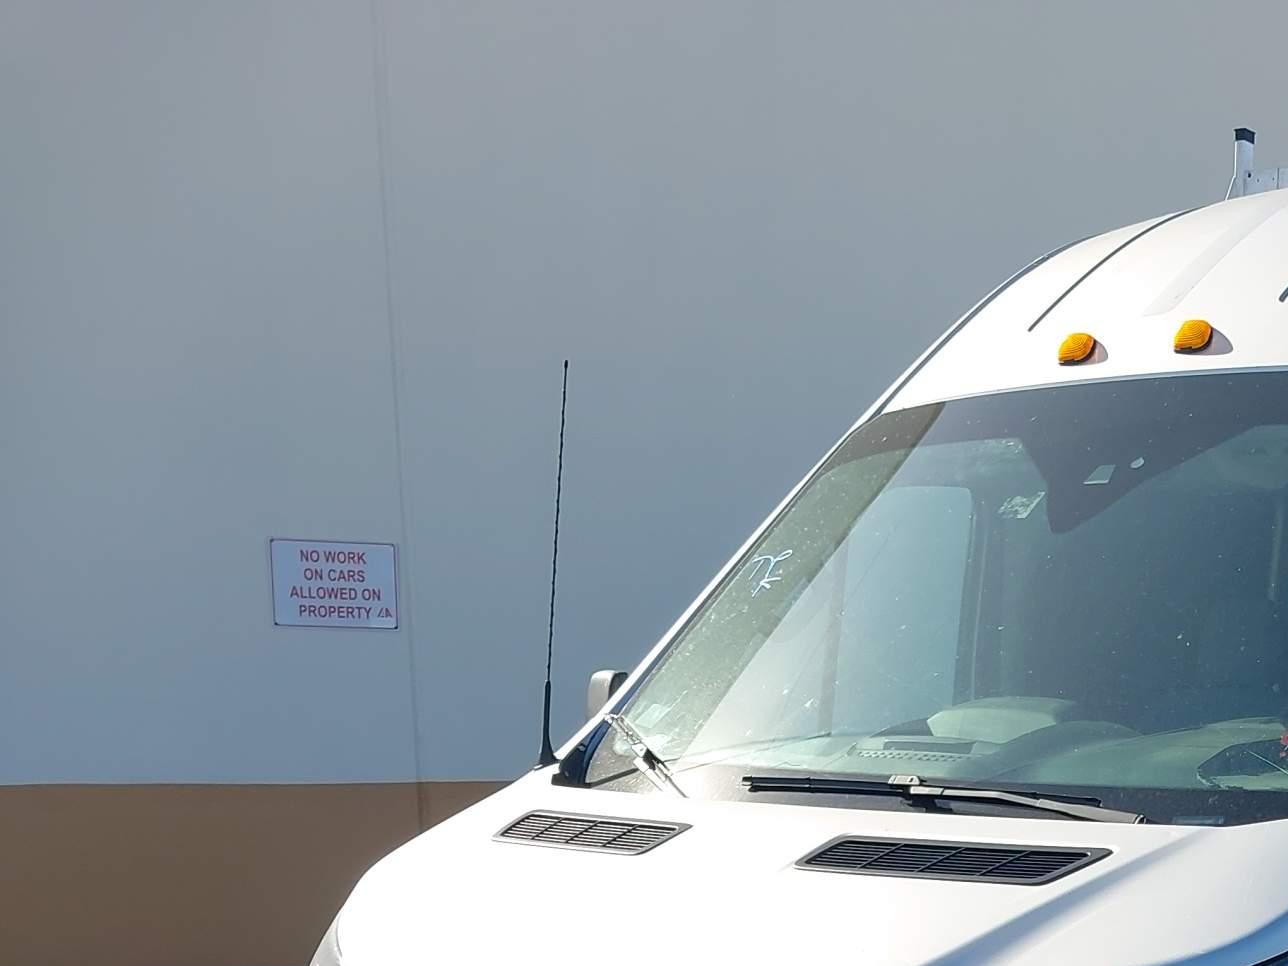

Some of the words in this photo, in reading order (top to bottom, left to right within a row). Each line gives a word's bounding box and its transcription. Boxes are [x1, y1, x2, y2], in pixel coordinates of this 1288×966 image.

[300, 549, 320, 563] NO
[324, 551, 367, 565] WORK
[303, 568, 323, 581] ON
[327, 569, 366, 583] CARS
[289, 586, 358, 600] ALLOWED
[361, 589, 381, 601] ON
[299, 605, 372, 619] PROPERTY
